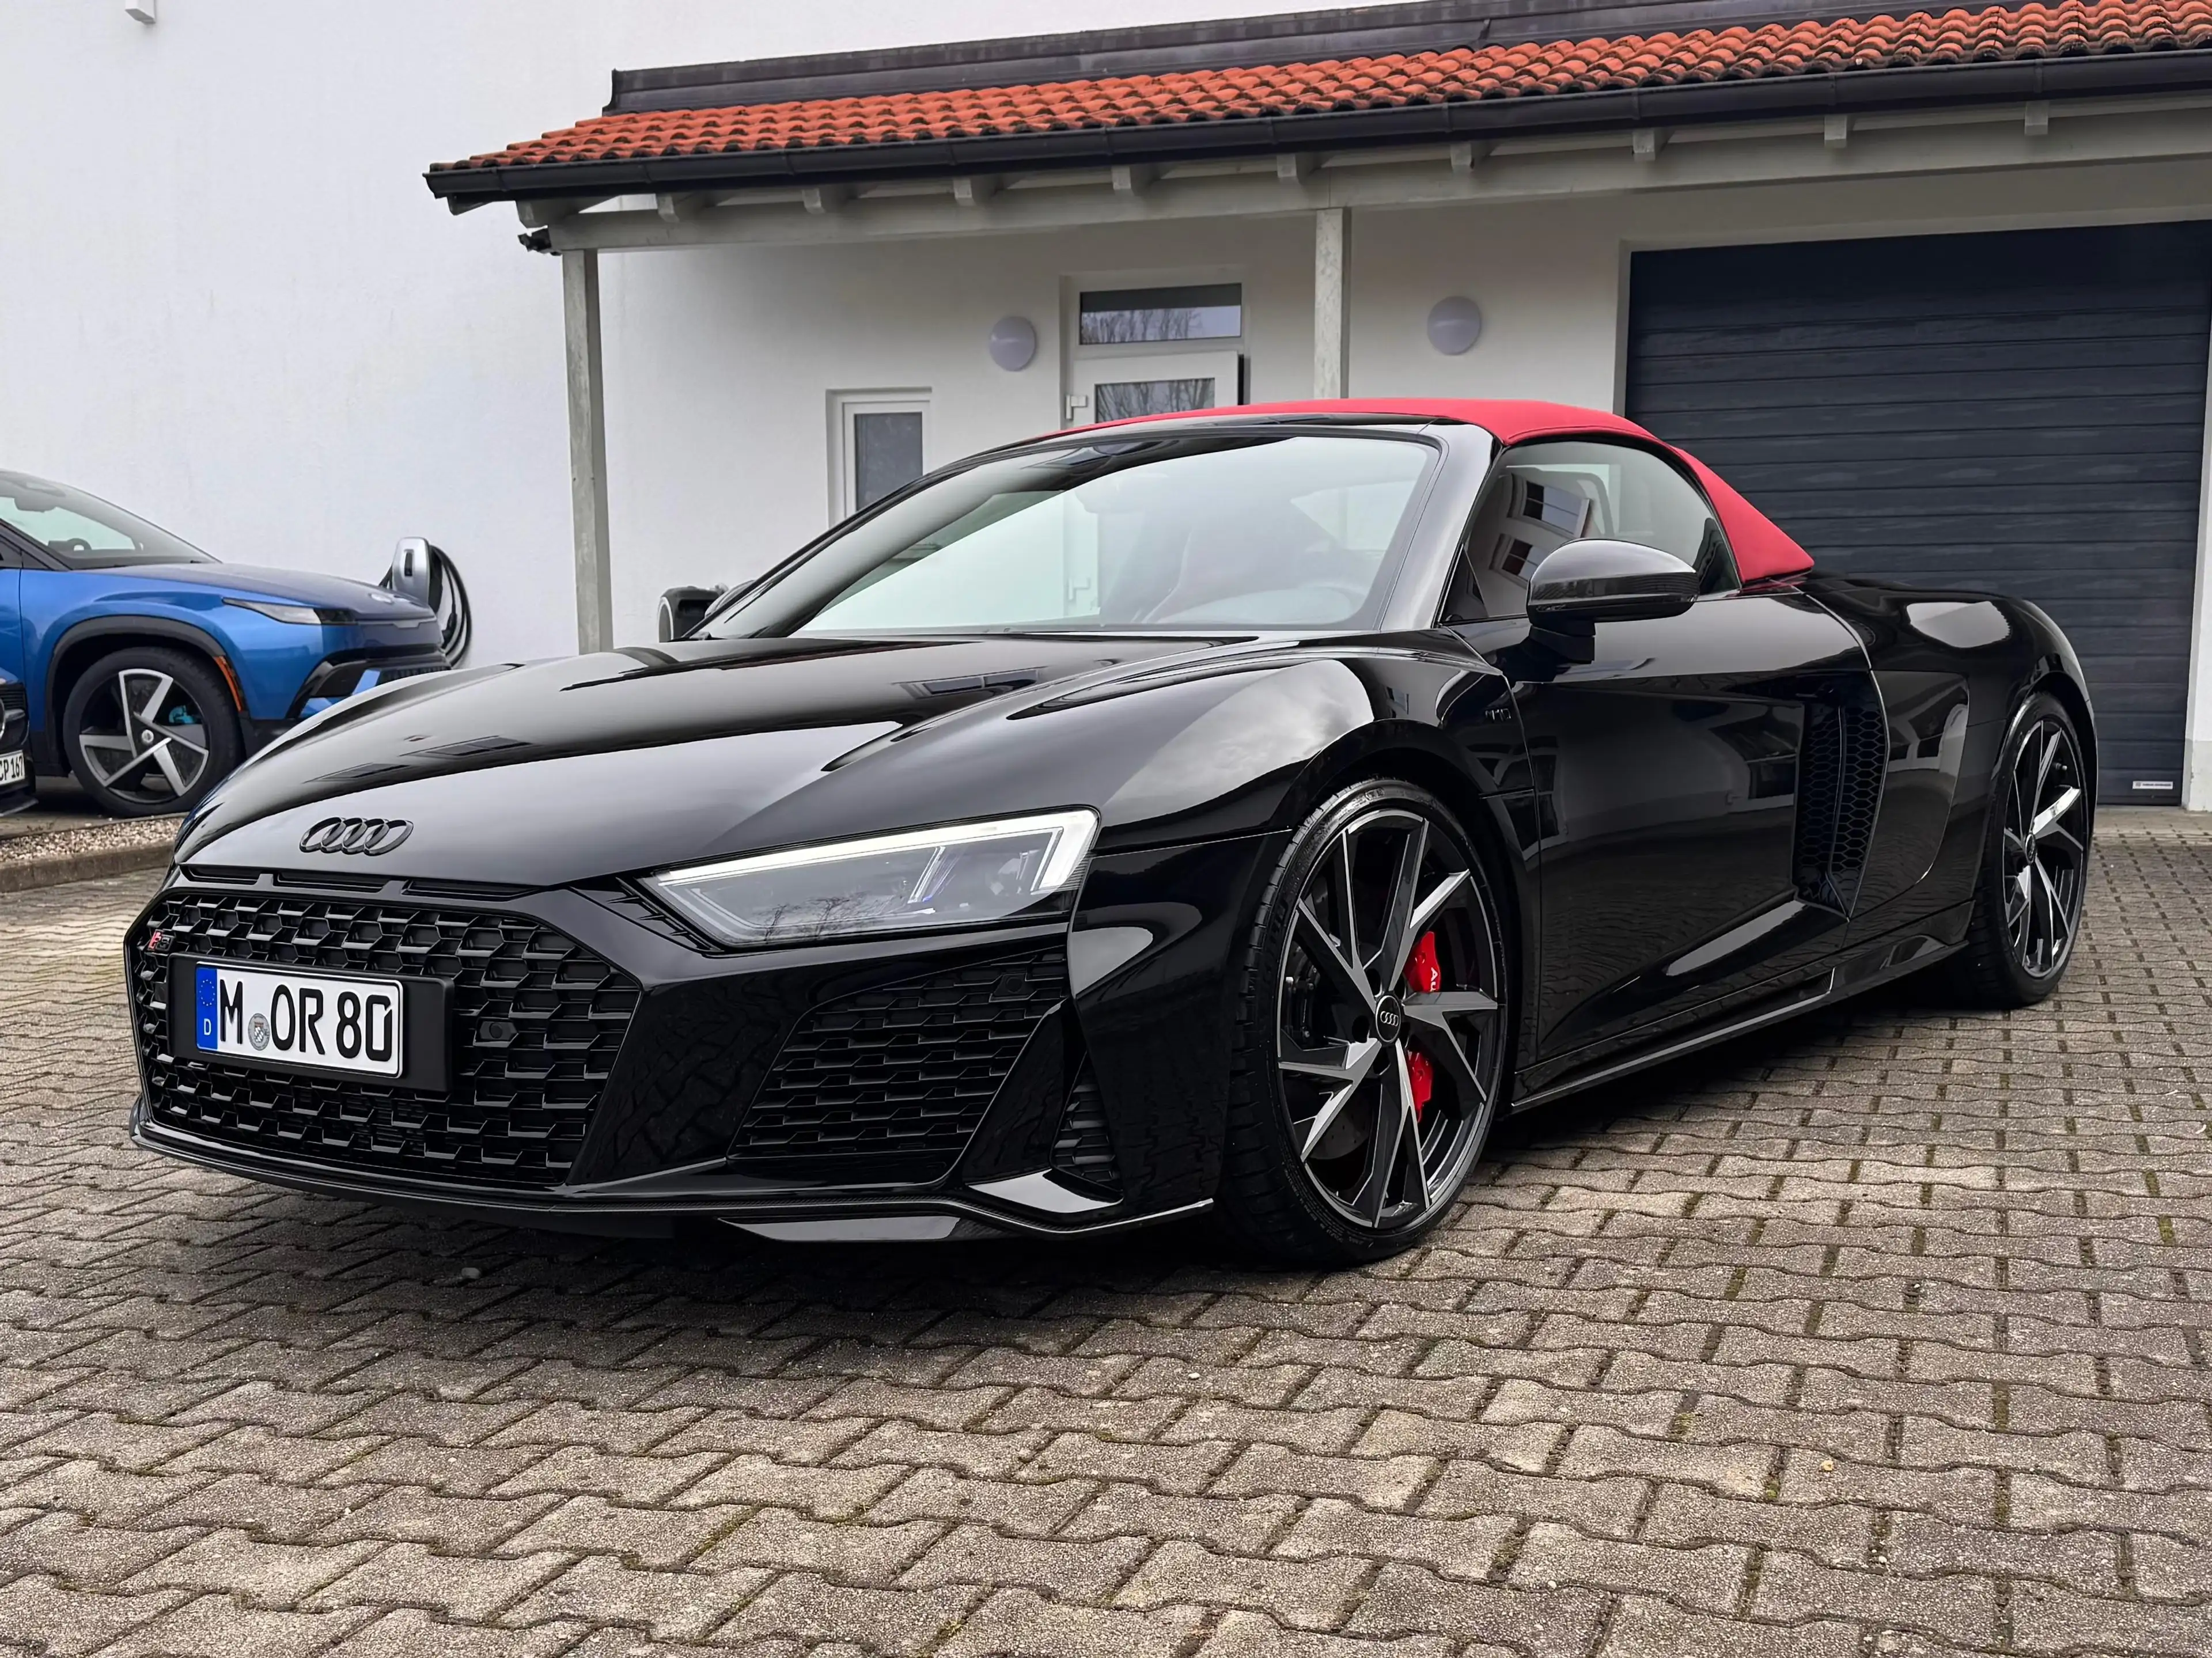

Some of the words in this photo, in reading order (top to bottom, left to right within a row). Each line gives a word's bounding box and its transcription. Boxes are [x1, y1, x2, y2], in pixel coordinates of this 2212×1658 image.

[10, 755, 23, 778] 167
[203, 1018, 211, 1035] D
[219, 979, 243, 1045] M
[270, 984, 325, 1055] OR
[336, 991, 393, 1062] 80
